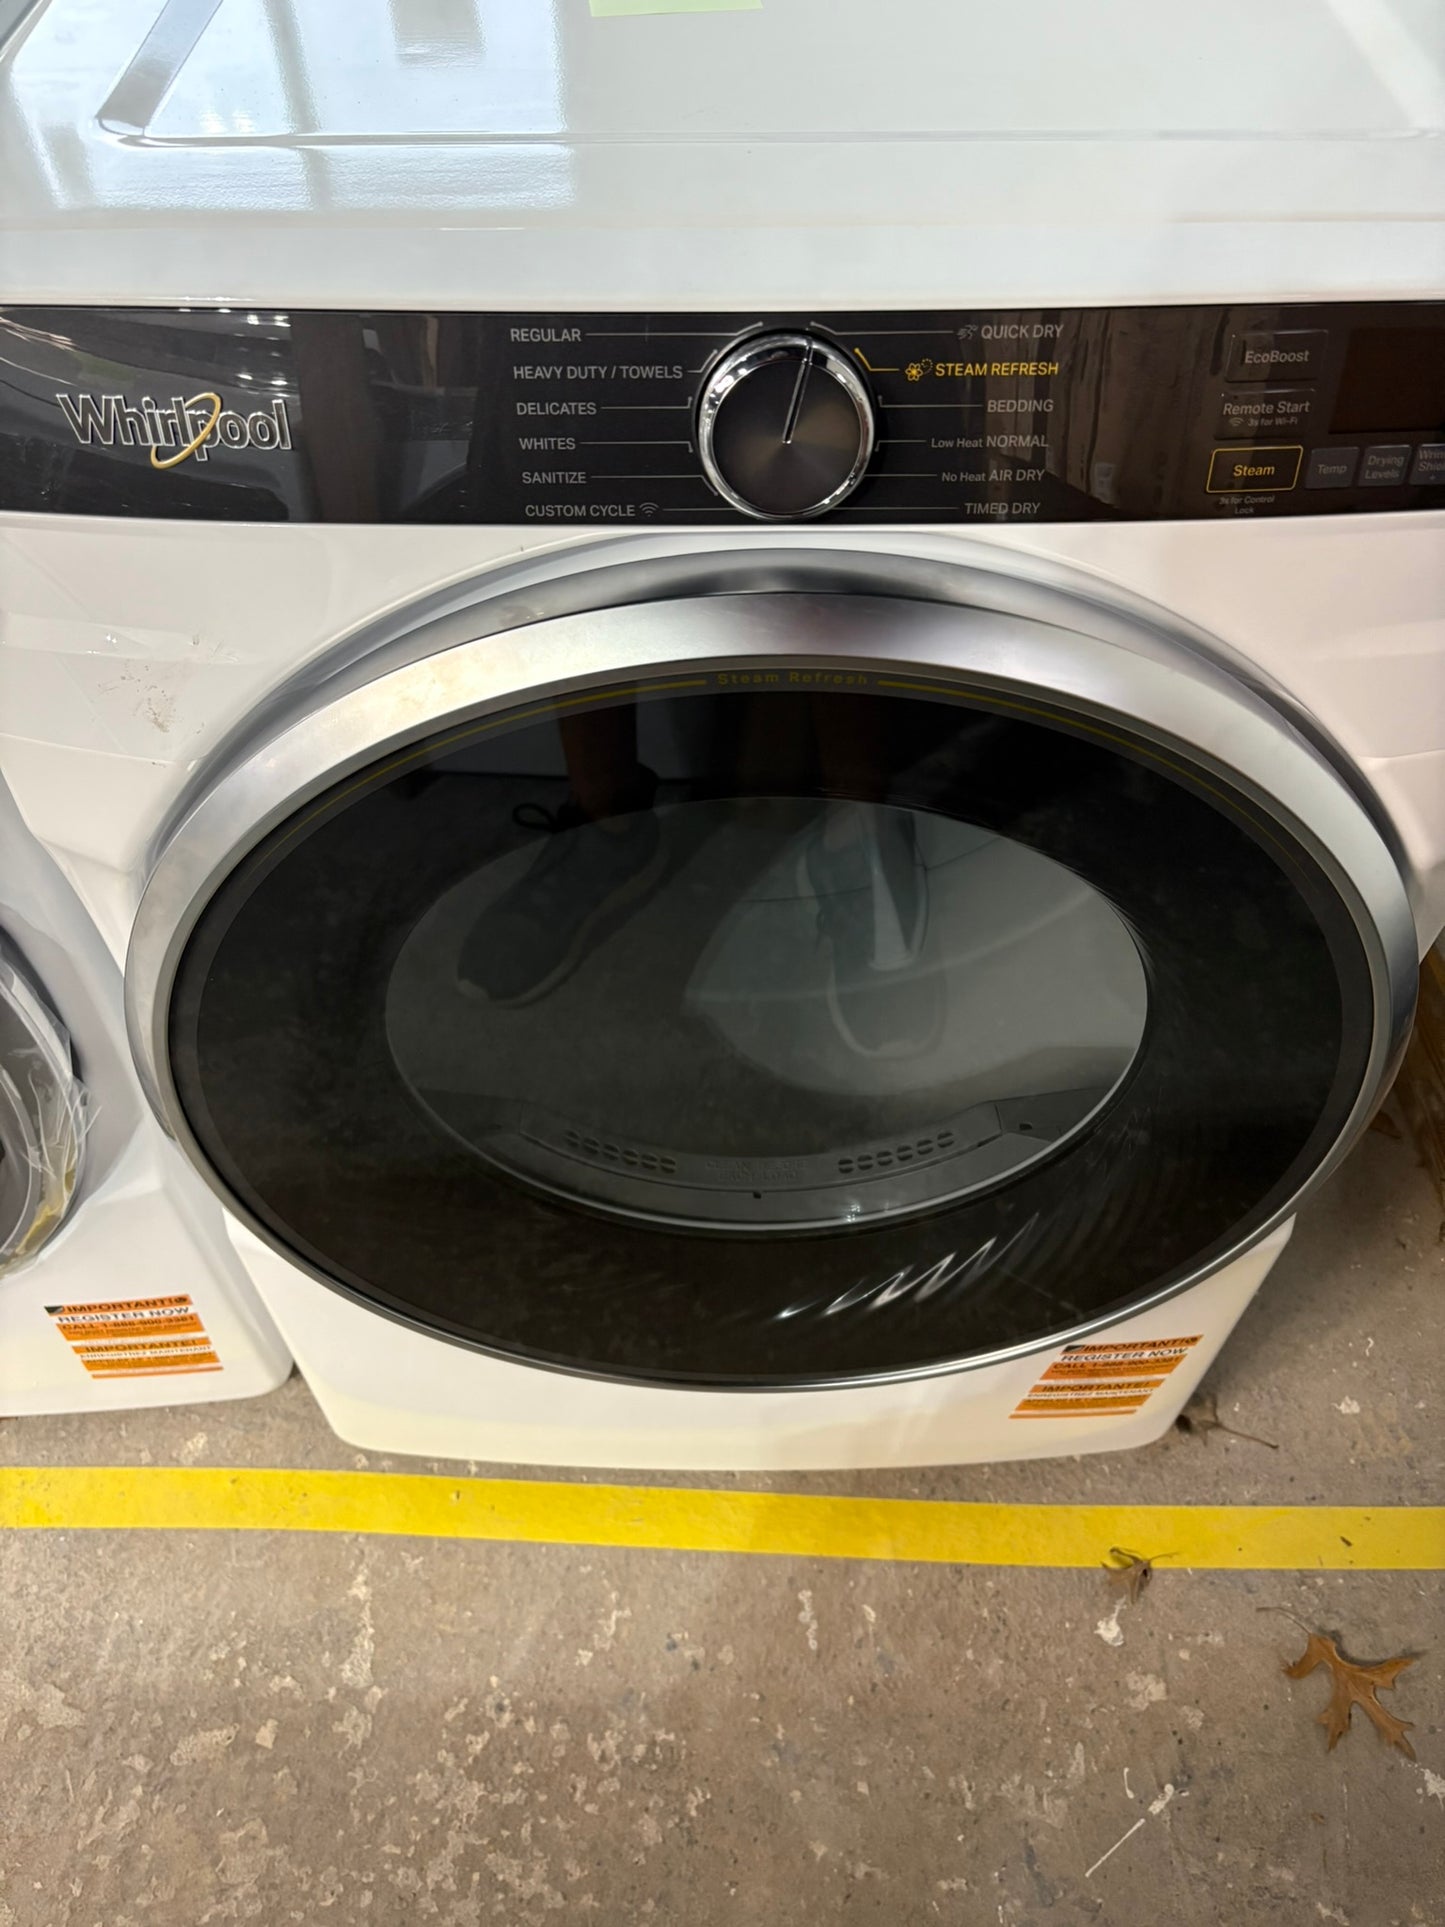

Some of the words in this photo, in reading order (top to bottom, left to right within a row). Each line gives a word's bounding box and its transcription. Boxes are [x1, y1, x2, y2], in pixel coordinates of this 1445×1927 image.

[510, 328, 582, 342] REGULAR
[981, 324, 1029, 340] QUICK
[1032, 324, 1064, 339] DRY
[1243, 349, 1310, 364] EcoBoost
[513, 366, 563, 379] HEAVY
[567, 366, 607, 379] DUTY
[611, 366, 617, 378] /
[619, 365, 683, 379] TOWELS
[935, 363, 988, 377] STEAM
[991, 362, 1059, 376] REFRESH
[516, 402, 597, 416] DELICATES
[986, 399, 1054, 413] BEDDING
[1223, 402, 1274, 416] Remote
[1276, 400, 1311, 414] Start
[56, 392, 292, 463] Whirlpool
[1260, 418, 1273, 426] for
[1275, 416, 1298, 426] Wi-Fi
[519, 437, 576, 450] WHITES
[931, 438, 954, 449] Low
[956, 437, 983, 449] Heat
[986, 435, 1049, 448] NORMAL
[1367, 454, 1405, 467] Drying
[941, 472, 957, 482] No
[959, 471, 986, 482] Heat
[988, 469, 1013, 482] AIR
[1015, 469, 1046, 482] DRY
[1233, 464, 1275, 477] Steam
[1316, 464, 1348, 475] Temp
[1364, 469, 1400, 480] Levels
[522, 471, 587, 484] SANITIZE
[1244, 495, 1276, 504] Control
[525, 504, 587, 517] CUSTOM
[590, 504, 635, 517] CYCLE
[964, 502, 1009, 515] TIMED
[1011, 502, 1040, 514] DRY
[717, 672, 780, 686] Steam
[788, 671, 868, 685] Refresh
[58, 1310, 145, 1323] REGISTER
[149, 1306, 190, 1318] NOW
[62, 1321, 99, 1331] CALL
[1061, 1351, 1145, 1362] REGISTER
[1148, 1346, 1189, 1358] NOW
[1053, 1361, 1087, 1370] CALL
